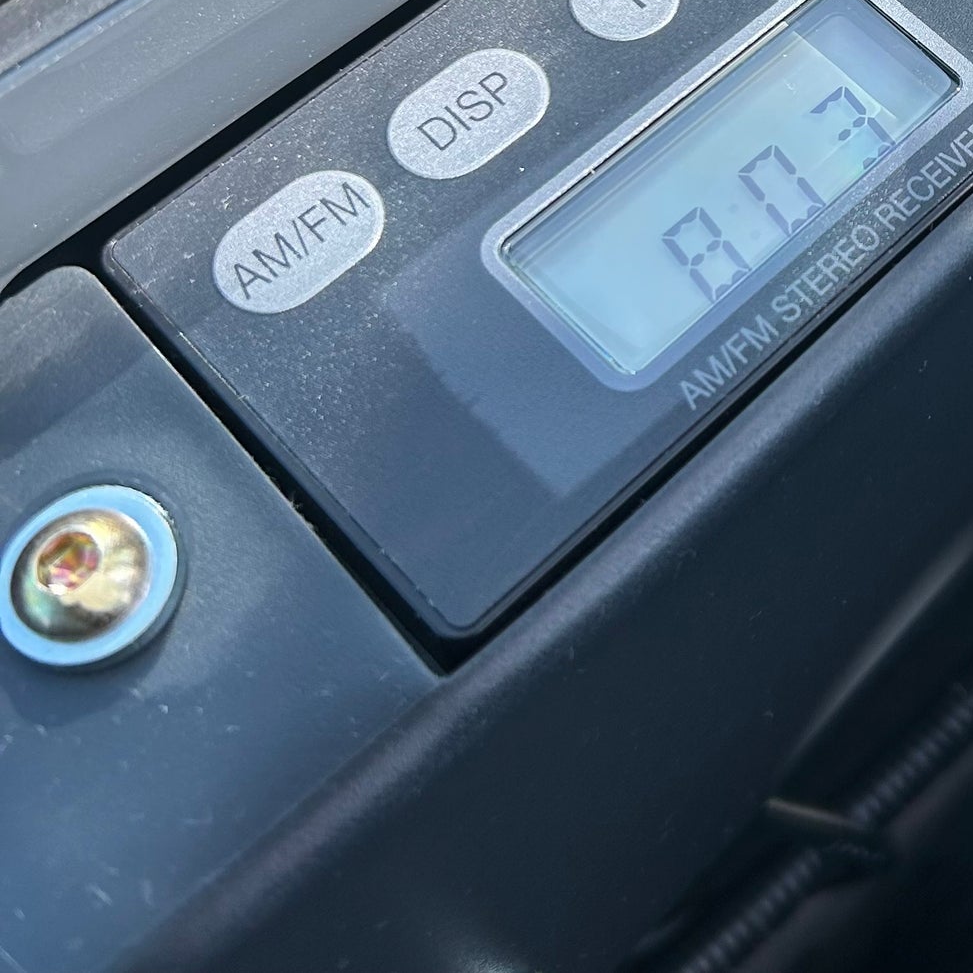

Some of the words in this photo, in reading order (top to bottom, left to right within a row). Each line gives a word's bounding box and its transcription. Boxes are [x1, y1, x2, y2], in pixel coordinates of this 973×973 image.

[416, 70, 509, 152] DISP
[231, 181, 372, 301] AM/FM
[679, 314, 780, 411] AM/FM
[772, 222, 881, 324] STEREO
